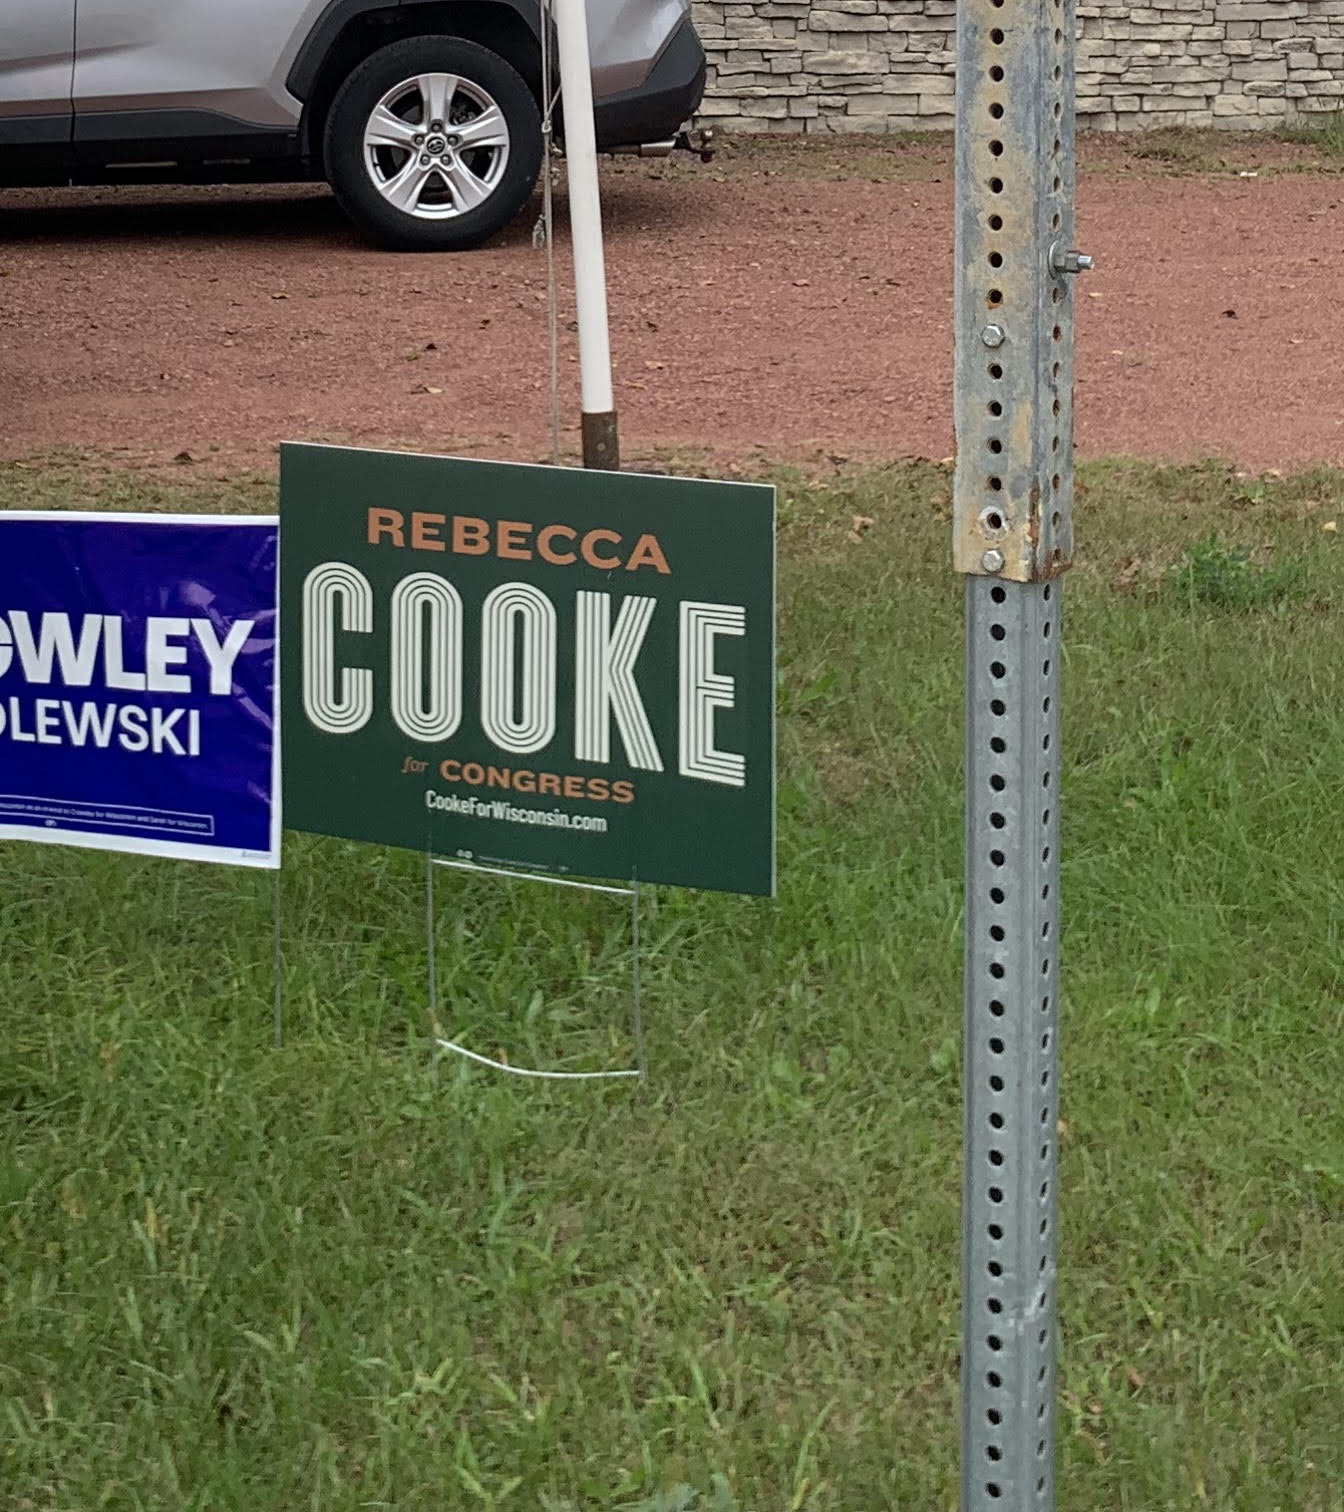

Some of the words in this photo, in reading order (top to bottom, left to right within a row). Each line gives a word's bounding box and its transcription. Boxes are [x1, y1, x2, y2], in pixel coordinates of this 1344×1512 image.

[367, 506, 671, 574] REBECCA
[302, 561, 746, 787] COOKE
[402, 755, 429, 774] for
[440, 760, 635, 804] CONGRESS
[425, 790, 607, 833] CookeForWisconsin.com
